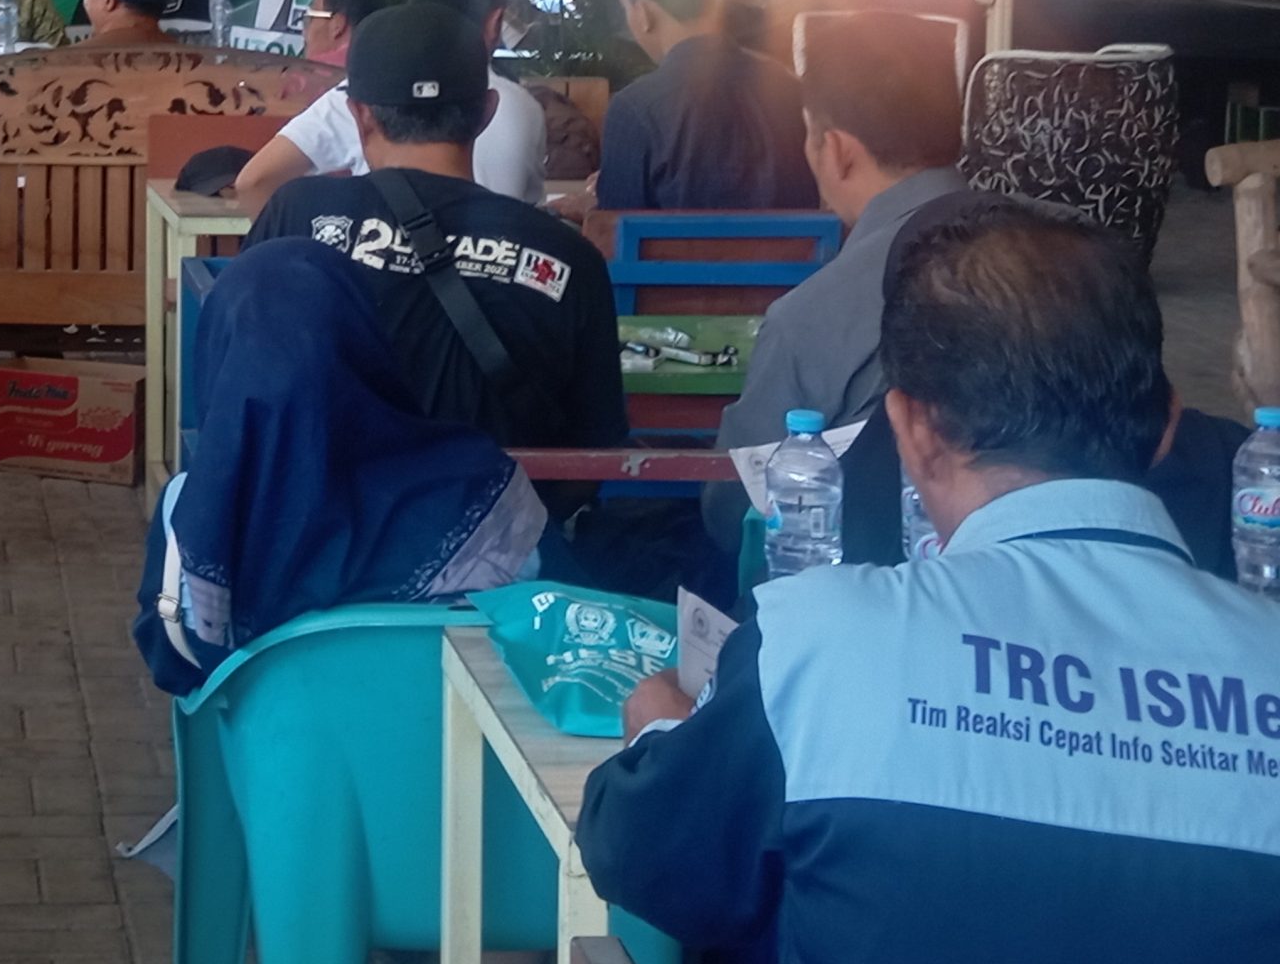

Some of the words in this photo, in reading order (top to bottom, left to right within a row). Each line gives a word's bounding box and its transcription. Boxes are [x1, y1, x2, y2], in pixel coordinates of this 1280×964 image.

[961, 633, 1095, 714] TRC
[907, 697, 947, 728] Tim
[956, 705, 1031, 743] Reaksi
[1039, 720, 1104, 757] Cepat
[1110, 733, 1153, 763] Info
[1160, 740, 1239, 773] Sekitar
